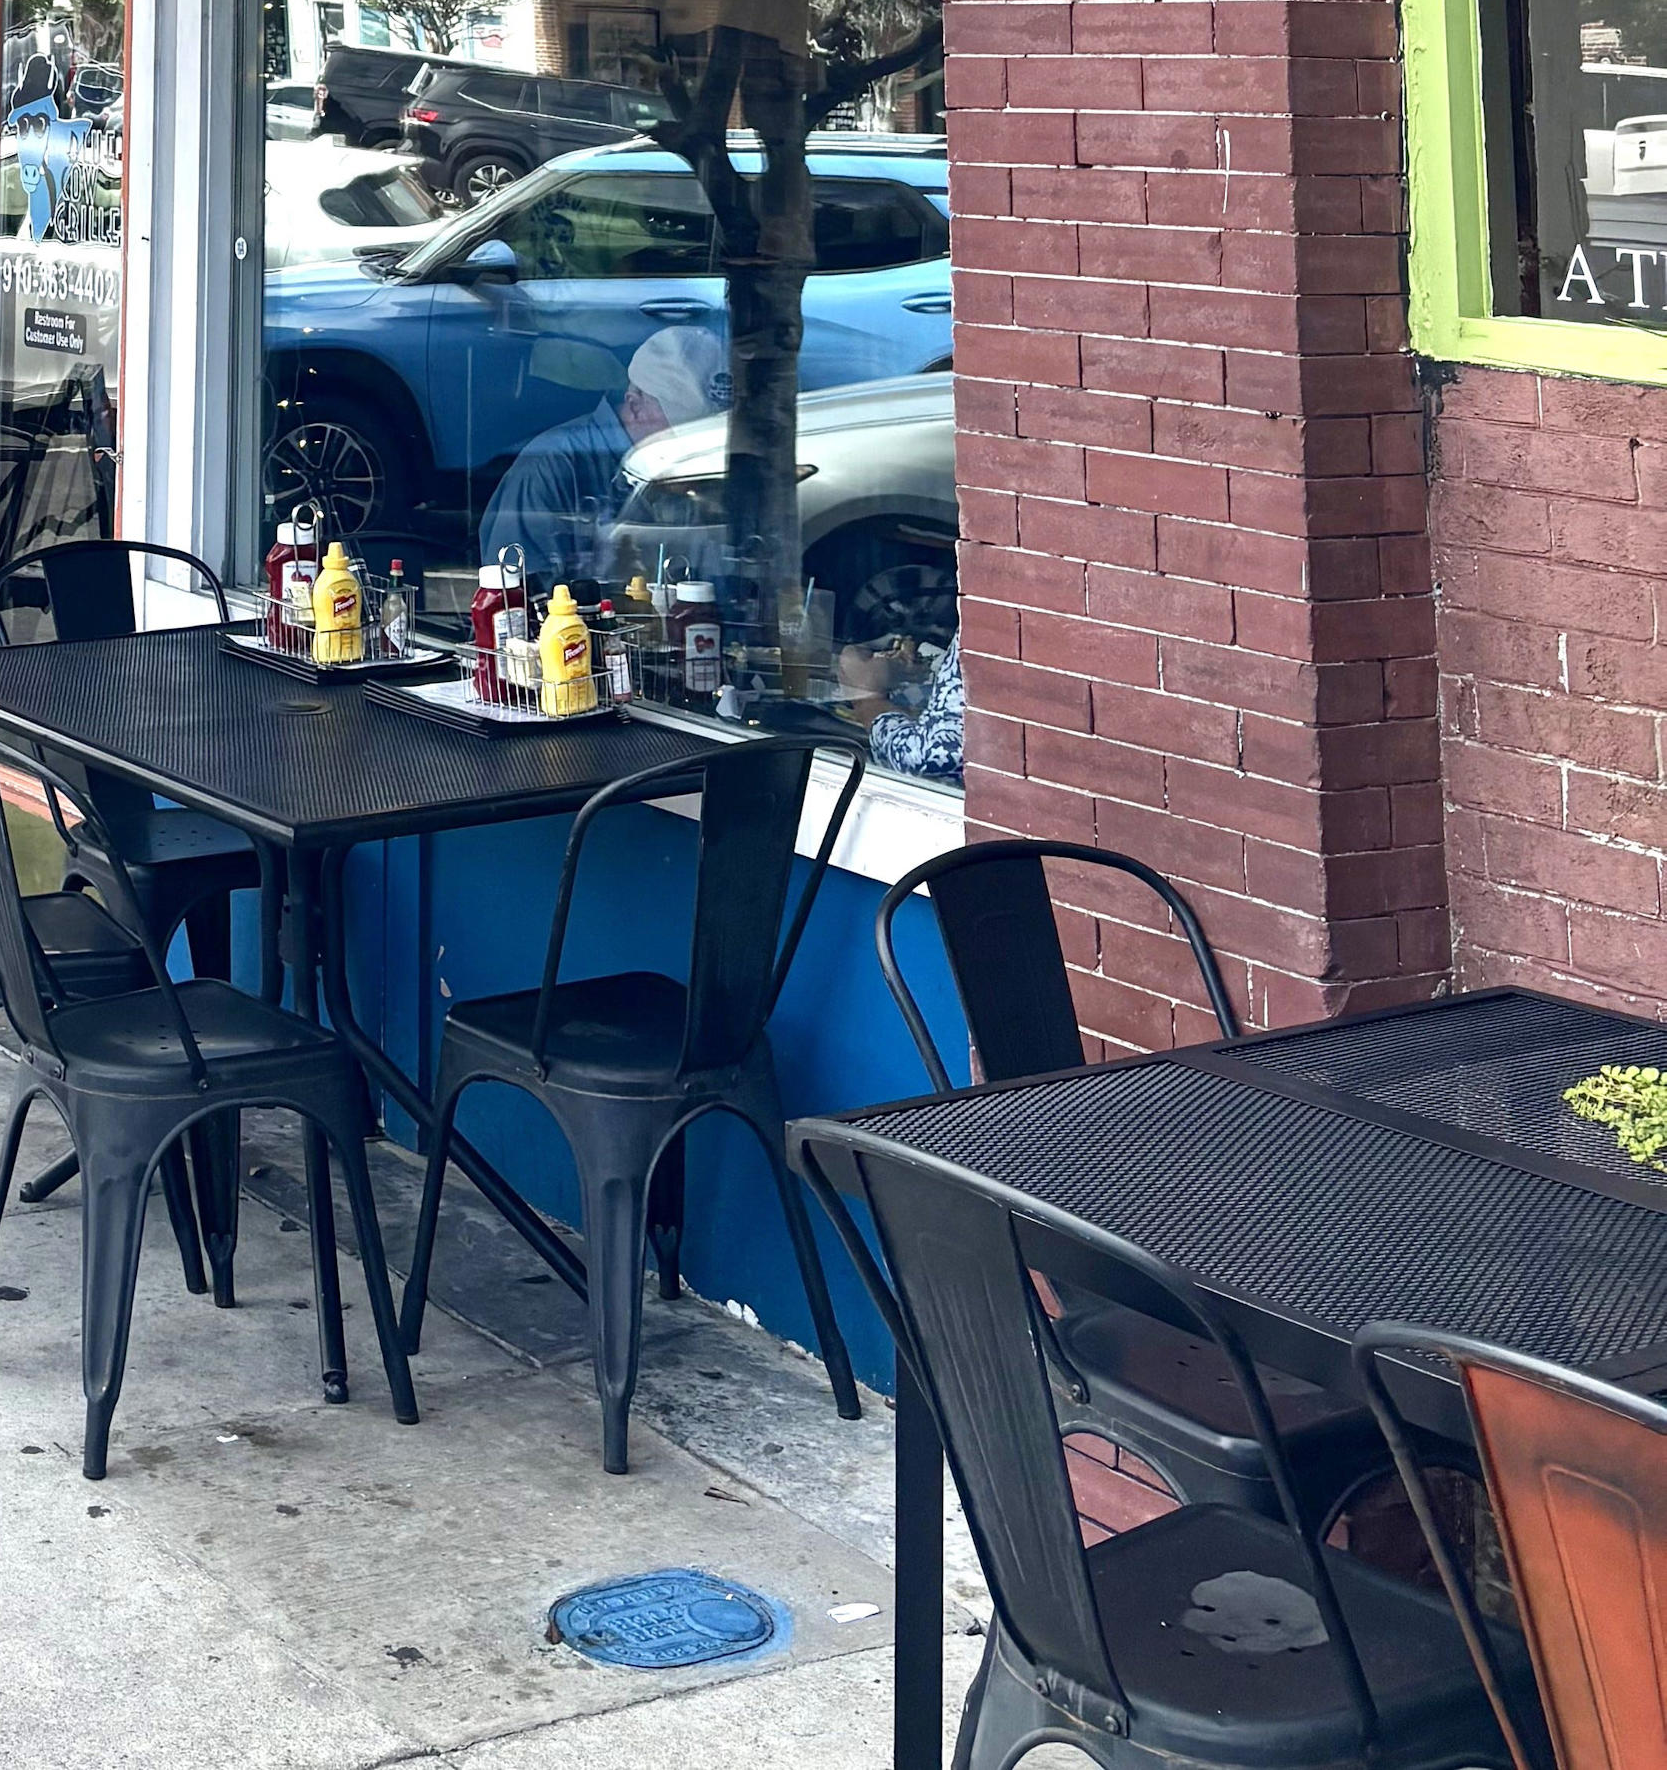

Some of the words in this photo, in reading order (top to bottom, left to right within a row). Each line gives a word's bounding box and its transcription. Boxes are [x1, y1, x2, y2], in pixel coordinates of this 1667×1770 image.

[61, 163, 100, 206] COW
[54, 201, 122, 247] GRILLE
[1556, 243, 1667, 310] AT
[25, 327, 55, 345] Customer
[56, 331, 68, 347] Use
[69, 333, 84, 354] Only
[34, 310, 64, 329] Restroom
[65, 314, 76, 330] For
